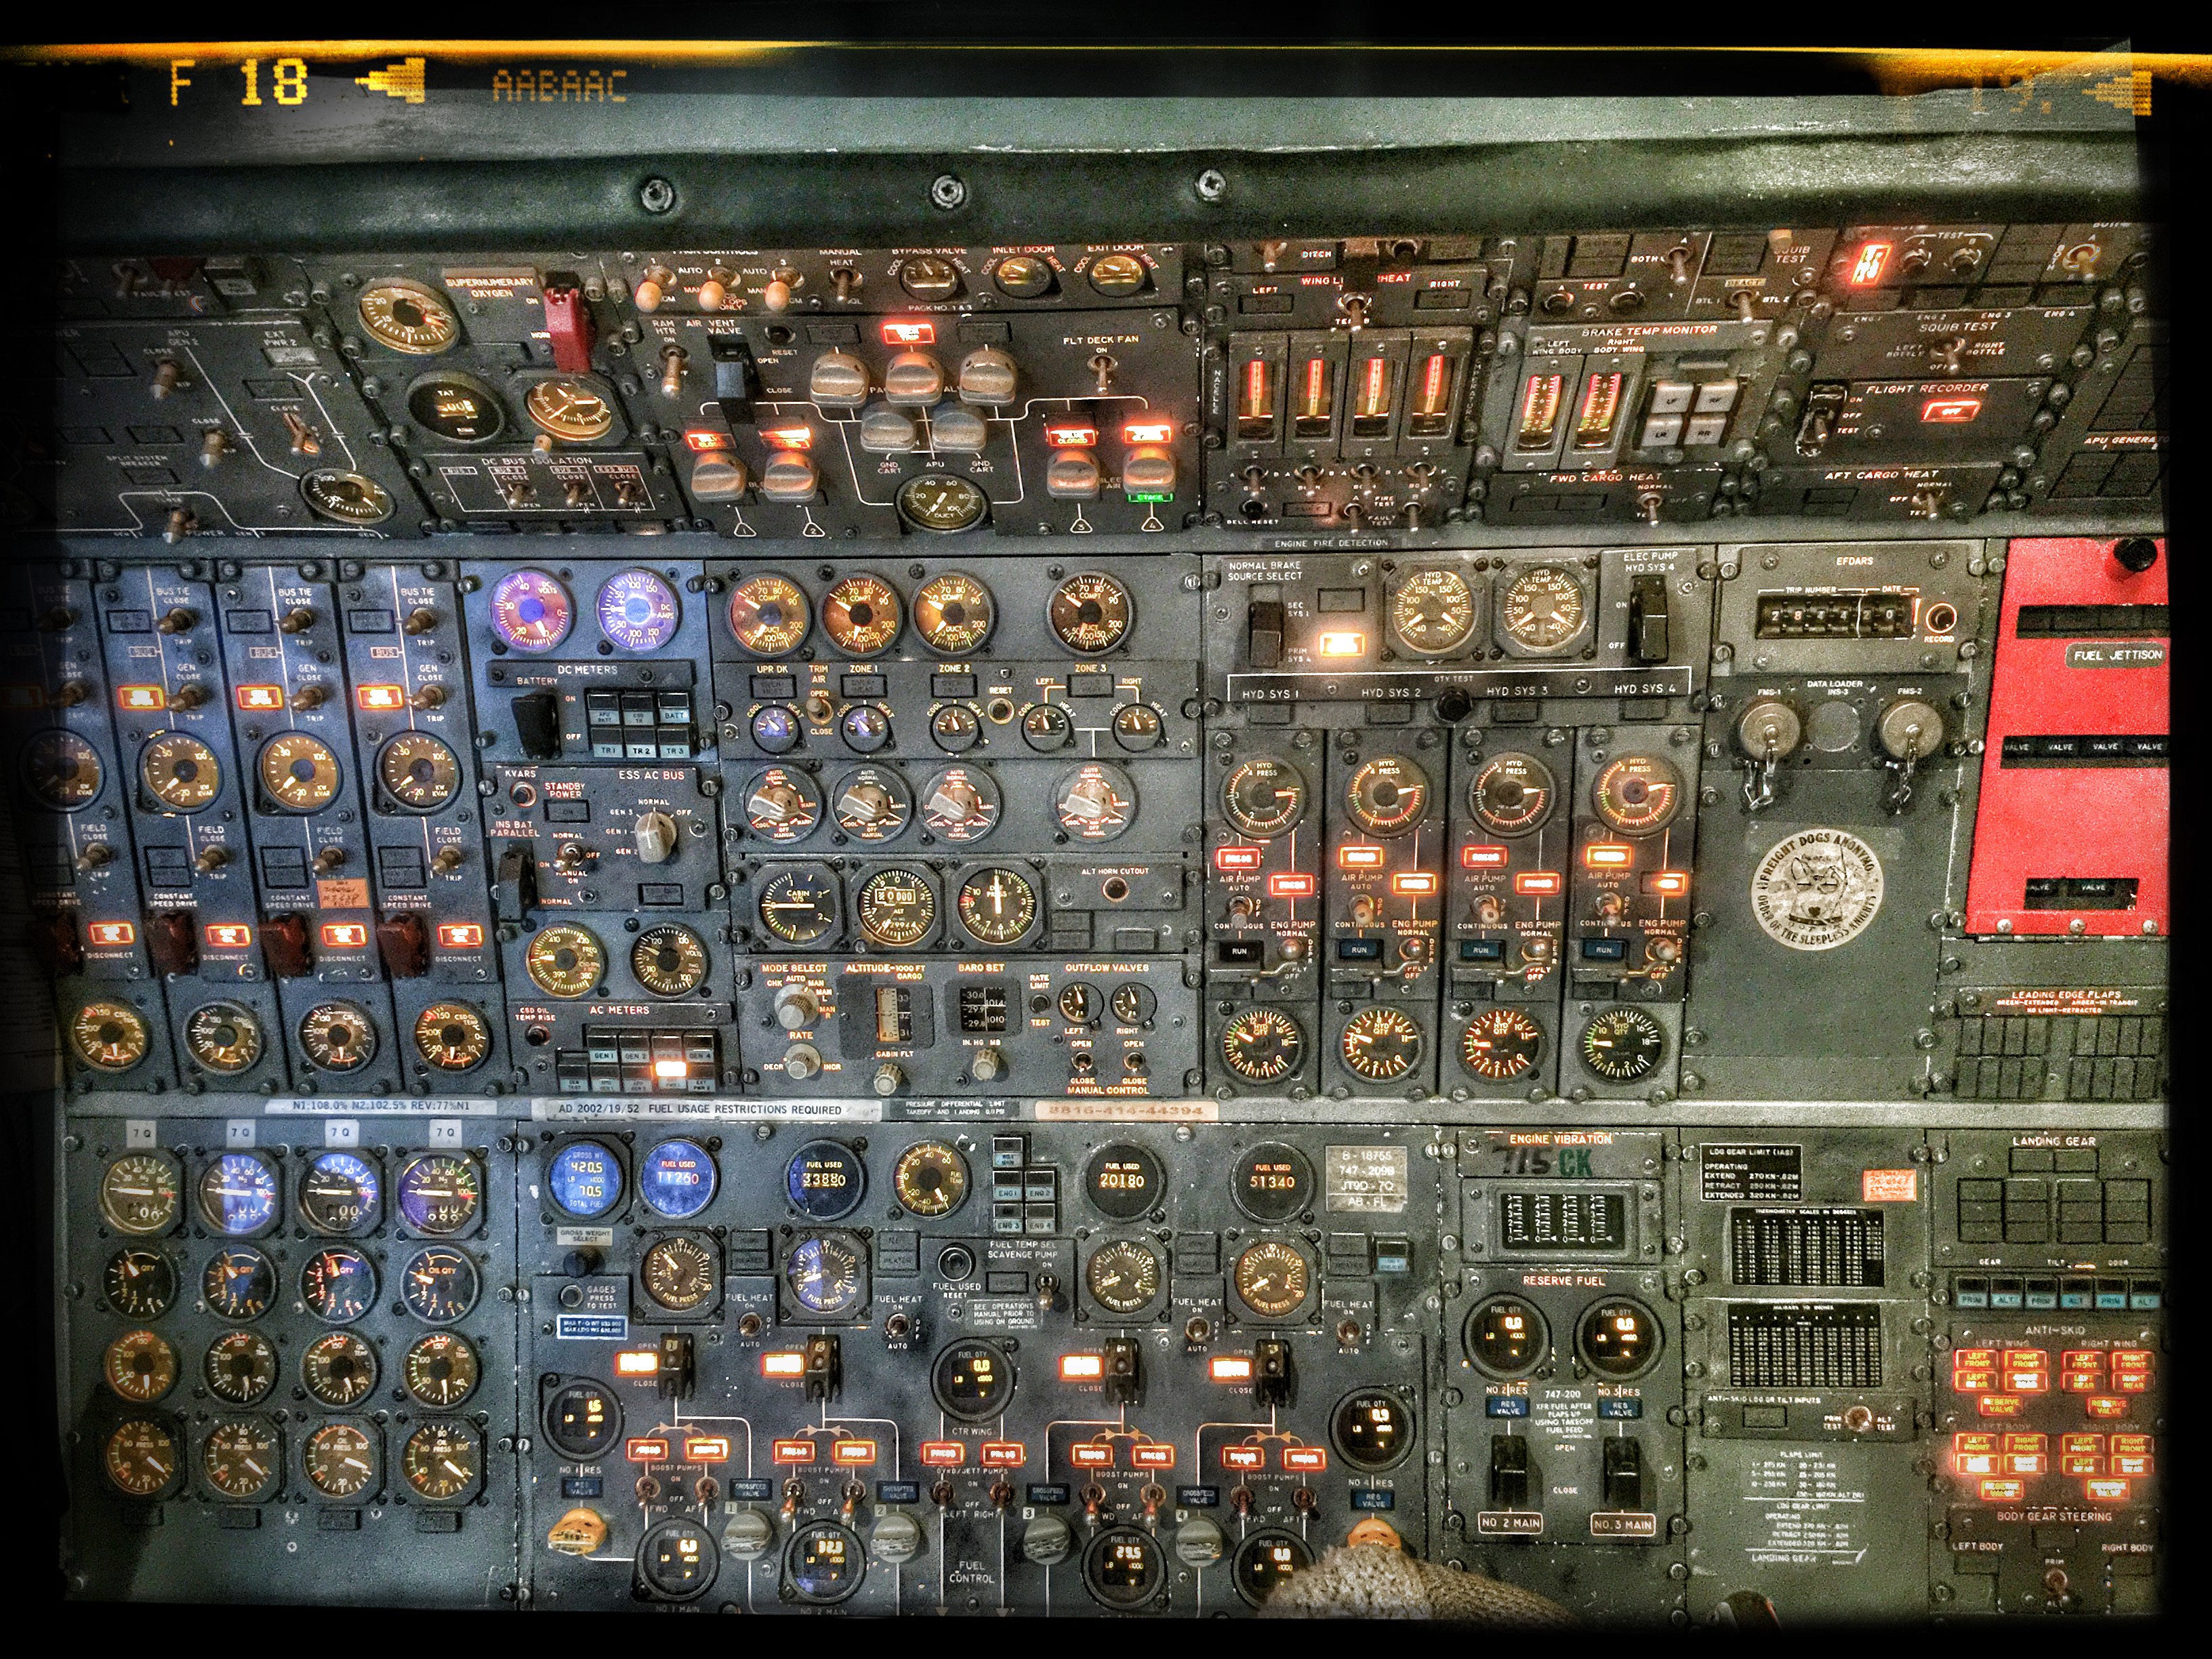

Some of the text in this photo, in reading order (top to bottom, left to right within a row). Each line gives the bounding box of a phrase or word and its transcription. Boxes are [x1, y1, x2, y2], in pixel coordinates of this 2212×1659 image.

[1380, 273, 1411, 282] HEAT
[446, 279, 534, 287] SUPERNUMERARY
[471, 289, 514, 298] OXYGEN
[1582, 325, 1718, 337] BRAKE TEMP MONITOR
[1919, 321, 1998, 333] SQUIB TEST
[1063, 337, 1082, 345] FLT
[1117, 335, 1139, 343] FAN
[1866, 383, 1989, 394] FLIGHT RECORDER
[1549, 472, 1662, 483] FWD CARGO HEAT
[1824, 470, 1939, 480] AFT CARGO HEAT
[1338, 539, 1388, 547] DETECTION
[1624, 552, 1678, 561] ELEC PUMP
[1836, 556, 1873, 565] EFDARS
[1229, 561, 1300, 570] NORMAL BRAKE
[1227, 572, 1303, 580] SOURCE SELECT
[2074, 651, 2163, 661] FUEL JETTISON
[558, 665, 618, 674] DC METERS
[517, 677, 558, 685] BATTERY
[1614, 684, 1675, 694] HYD SYS 4
[1242, 690, 1265, 699] HYD
[1269, 690, 1290, 699] SYS
[619, 771, 684, 779] ESS AC BUS
[550, 790, 582, 798] POWER
[495, 820, 511, 828] INS
[490, 829, 540, 837] PARALLEL
[1799, 833, 1830, 846] DOGS
[762, 964, 827, 972] MODE SELECT
[958, 964, 1005, 972] BARO SET
[1065, 964, 1149, 972] OUTFLOW VALVES
[2012, 990, 2122, 999] LEADING EDGE FLAPS
[590, 1005, 650, 1015] AC METERS
[1067, 1086, 1149, 1094] MANUAL CONTROL
[293, 1101, 469, 1110] N1:108.0% N2:102.5% REV:77%N1
[558, 1105, 842, 1115] AD 2002/19/52 FUEL USAGE RESTRICTIONS REQUIRED
[1510, 1134, 1612, 1143] ENGINE VIBRATION
[2013, 1137, 2096, 1145] LANDING GEAR
[1343, 1151, 1350, 1160] B
[571, 1162, 602, 1174] 420.5
[1339, 1166, 1358, 1174] 747
[1100, 1173, 1144, 1188] 20180
[1250, 1176, 1295, 1188] 51340
[580, 1185, 602, 1197] 70.5
[1523, 1276, 1605, 1286] RESERVE FUEL
[2025, 1326, 2085, 1335] ANTI-SKID
[1545, 1391, 1580, 1399] 747-200
[1997, 1512, 2112, 1521] BODY GEAR STEERING
[1482, 1519, 1496, 1527] NO
[1504, 1519, 1510, 1527] 2
[959, 1561, 985, 1570] FUEL
[949, 1574, 995, 1583] CONTROL
